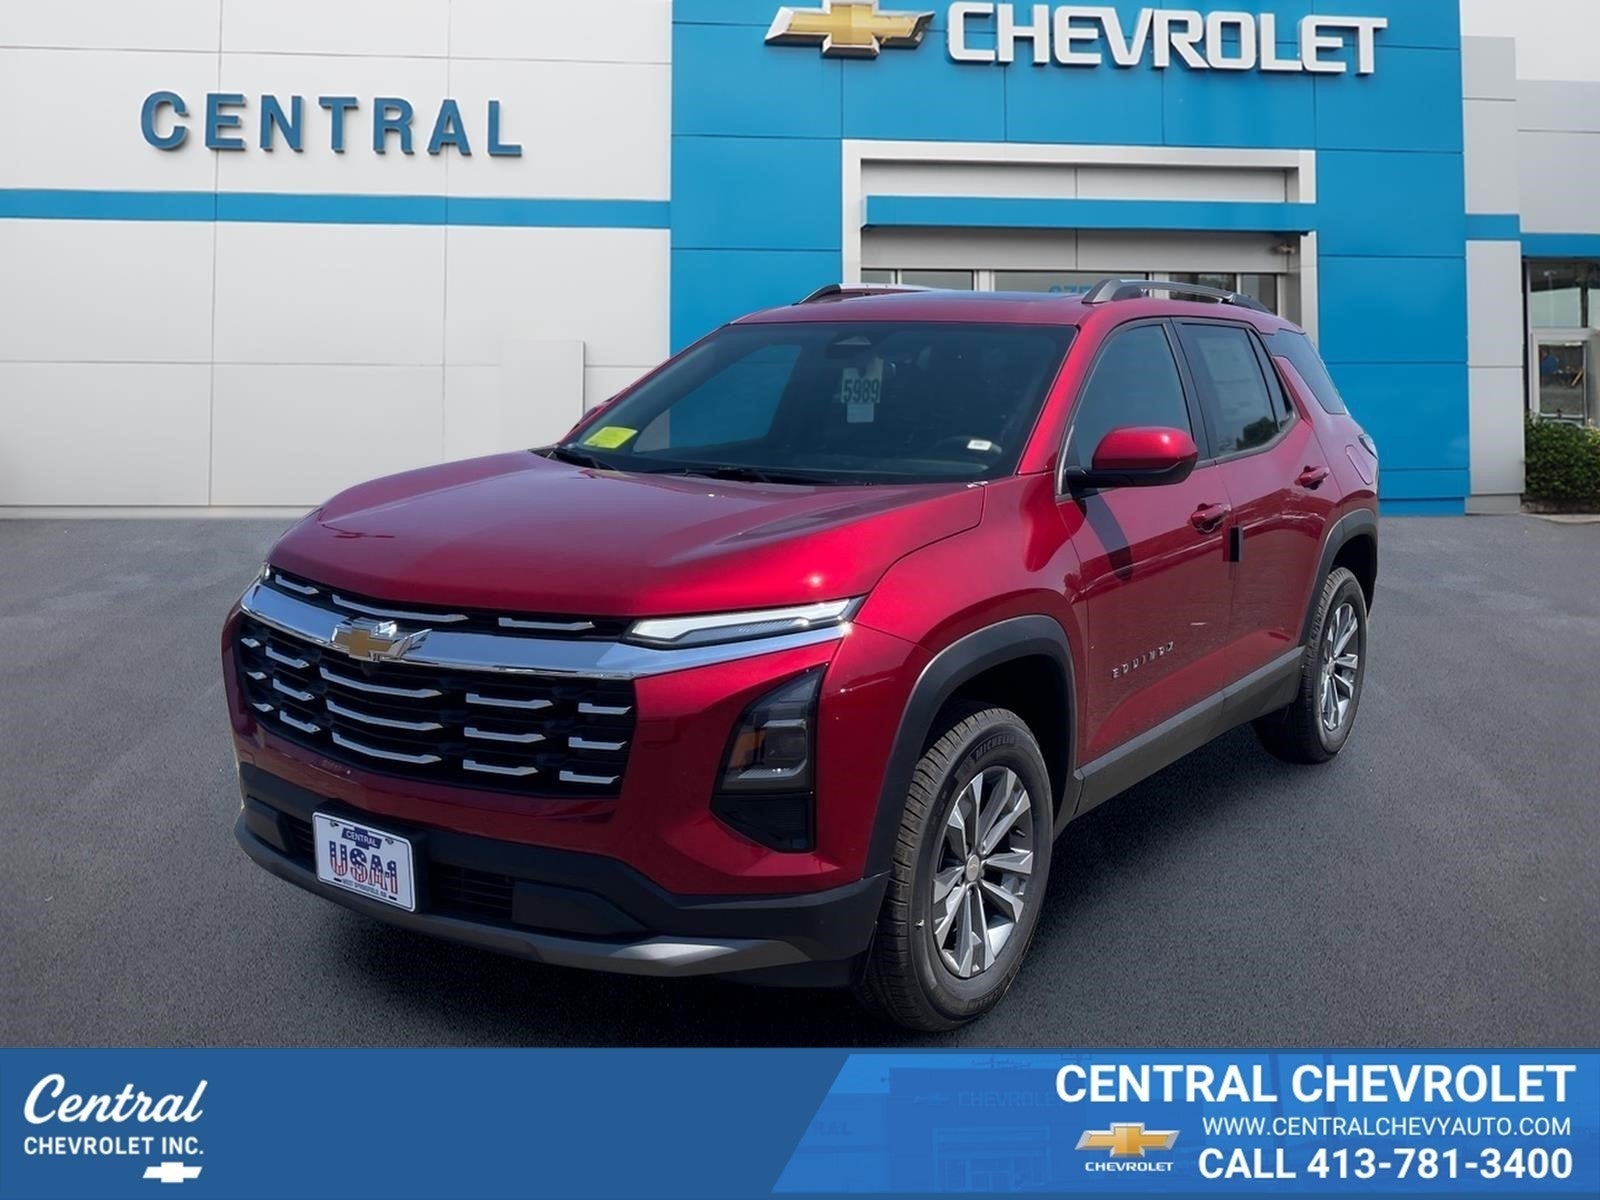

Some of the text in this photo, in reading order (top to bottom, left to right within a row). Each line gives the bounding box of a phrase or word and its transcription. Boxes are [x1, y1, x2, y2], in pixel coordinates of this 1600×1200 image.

[947, 0, 1388, 76] CHEVROLET
[140, 90, 523, 158] CENTRAL
[843, 379, 880, 402] 5989
[345, 829, 378, 847] CENTRAL
